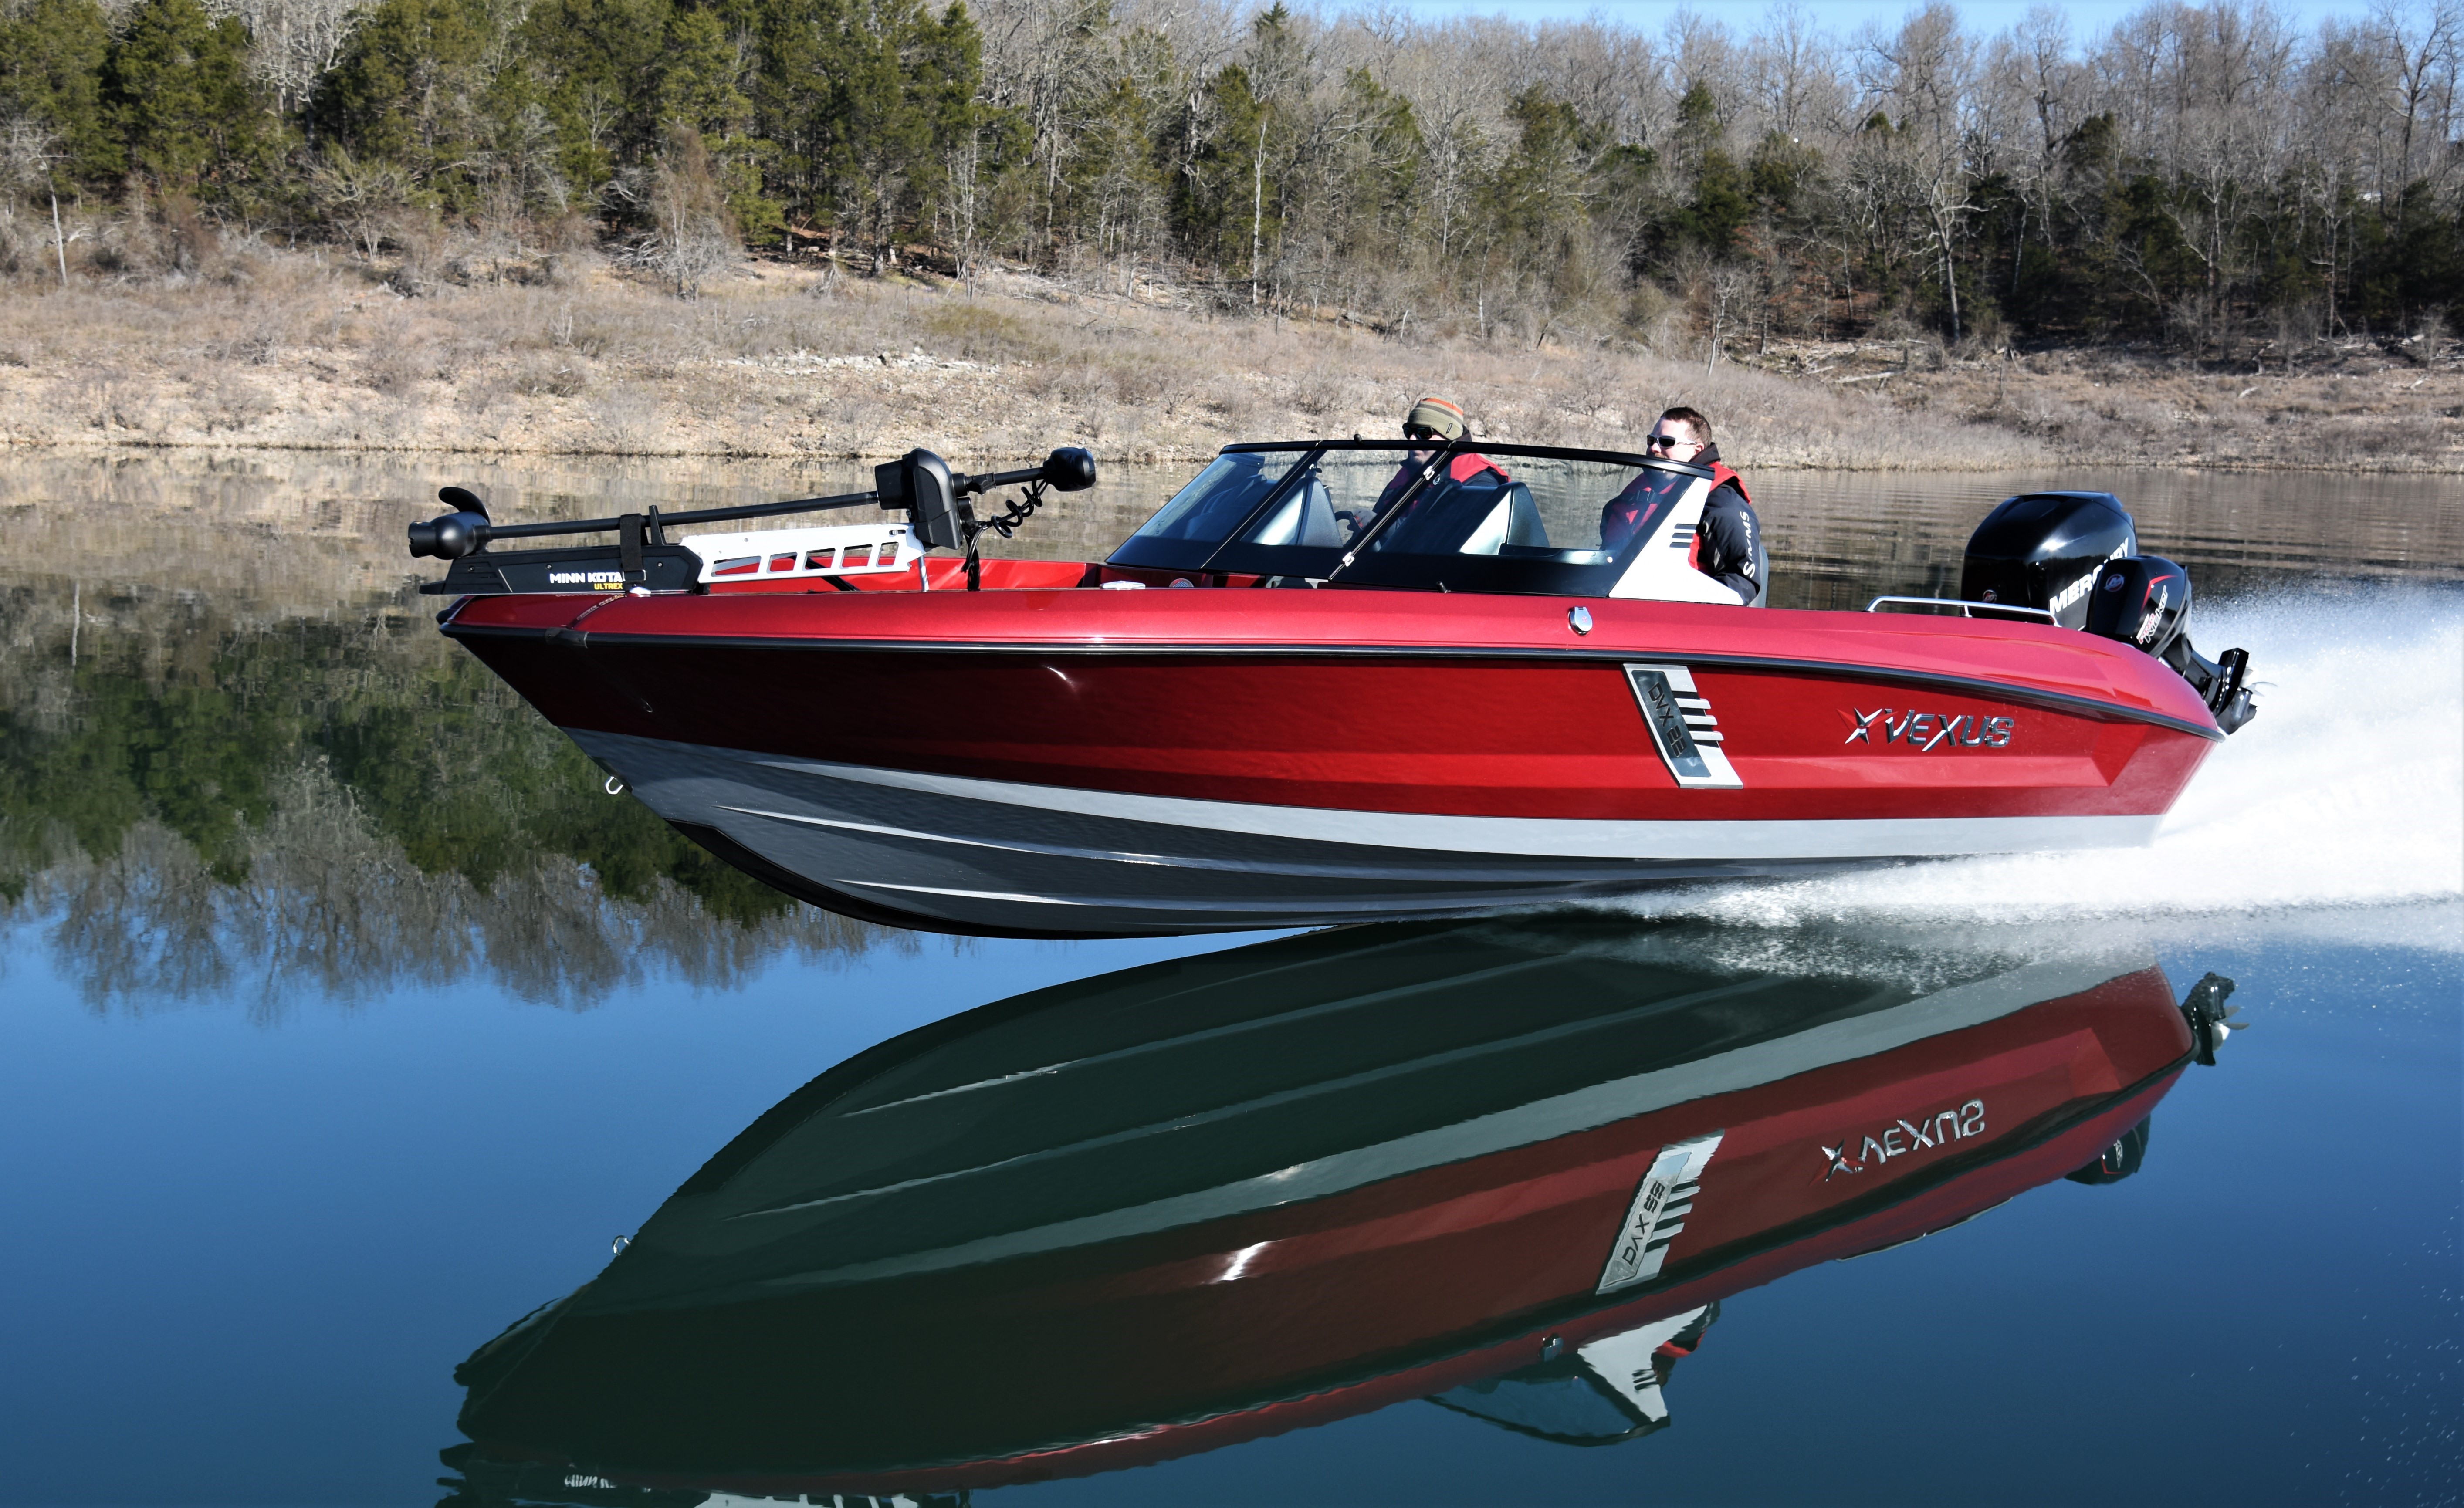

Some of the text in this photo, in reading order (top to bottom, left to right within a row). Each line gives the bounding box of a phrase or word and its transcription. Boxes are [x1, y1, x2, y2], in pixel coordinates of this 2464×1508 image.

[550, 572, 623, 583] MINN KOTA
[1740, 511, 1756, 578] SIMMS
[2049, 537, 2129, 615] MERCRY
[1648, 682, 1687, 757] DVX 22
[1885, 709, 2014, 752] VEXUS
